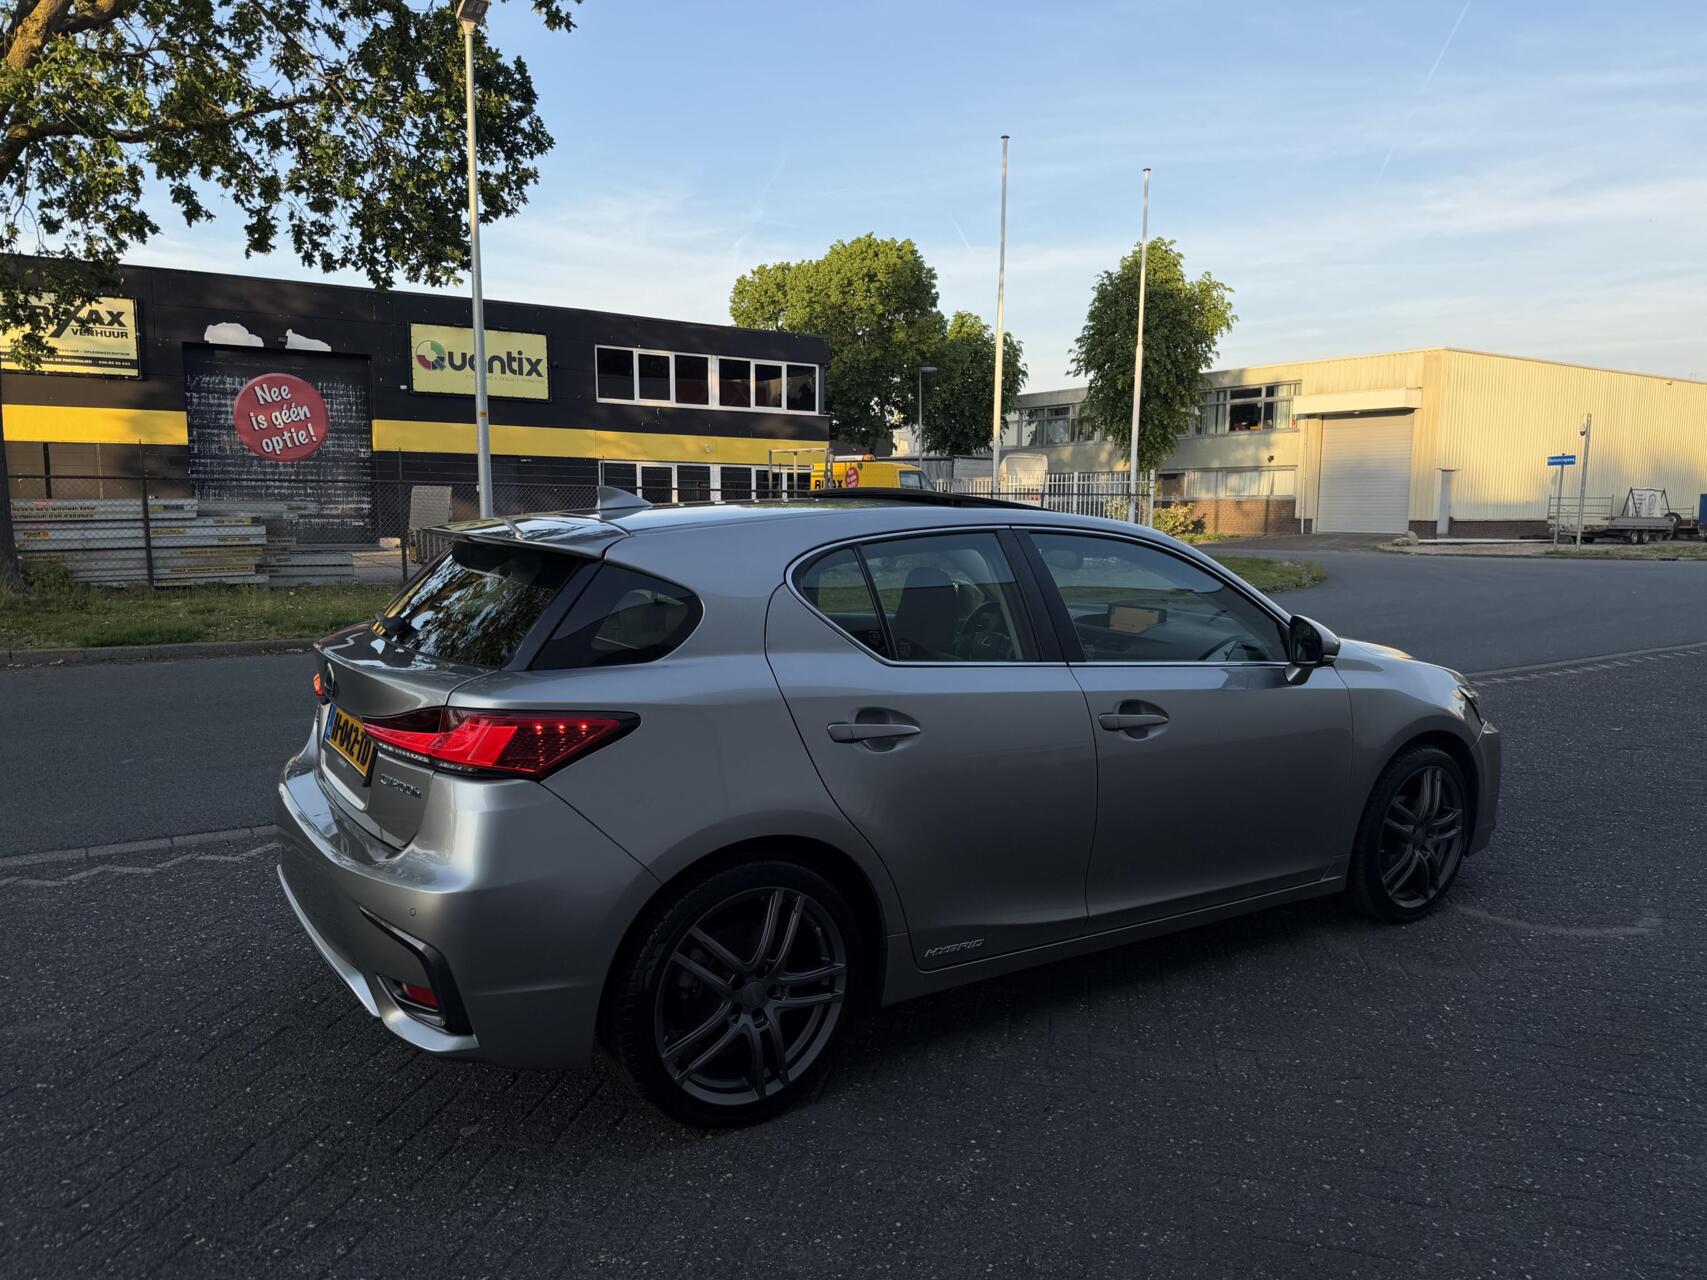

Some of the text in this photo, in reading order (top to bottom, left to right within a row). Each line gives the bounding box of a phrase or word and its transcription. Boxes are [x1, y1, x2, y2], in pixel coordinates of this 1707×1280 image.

[71, 328, 128, 339] VERHUUR
[254, 383, 292, 405] Nee
[249, 402, 312, 431] is géén
[924, 938, 985, 958] HYBRID
